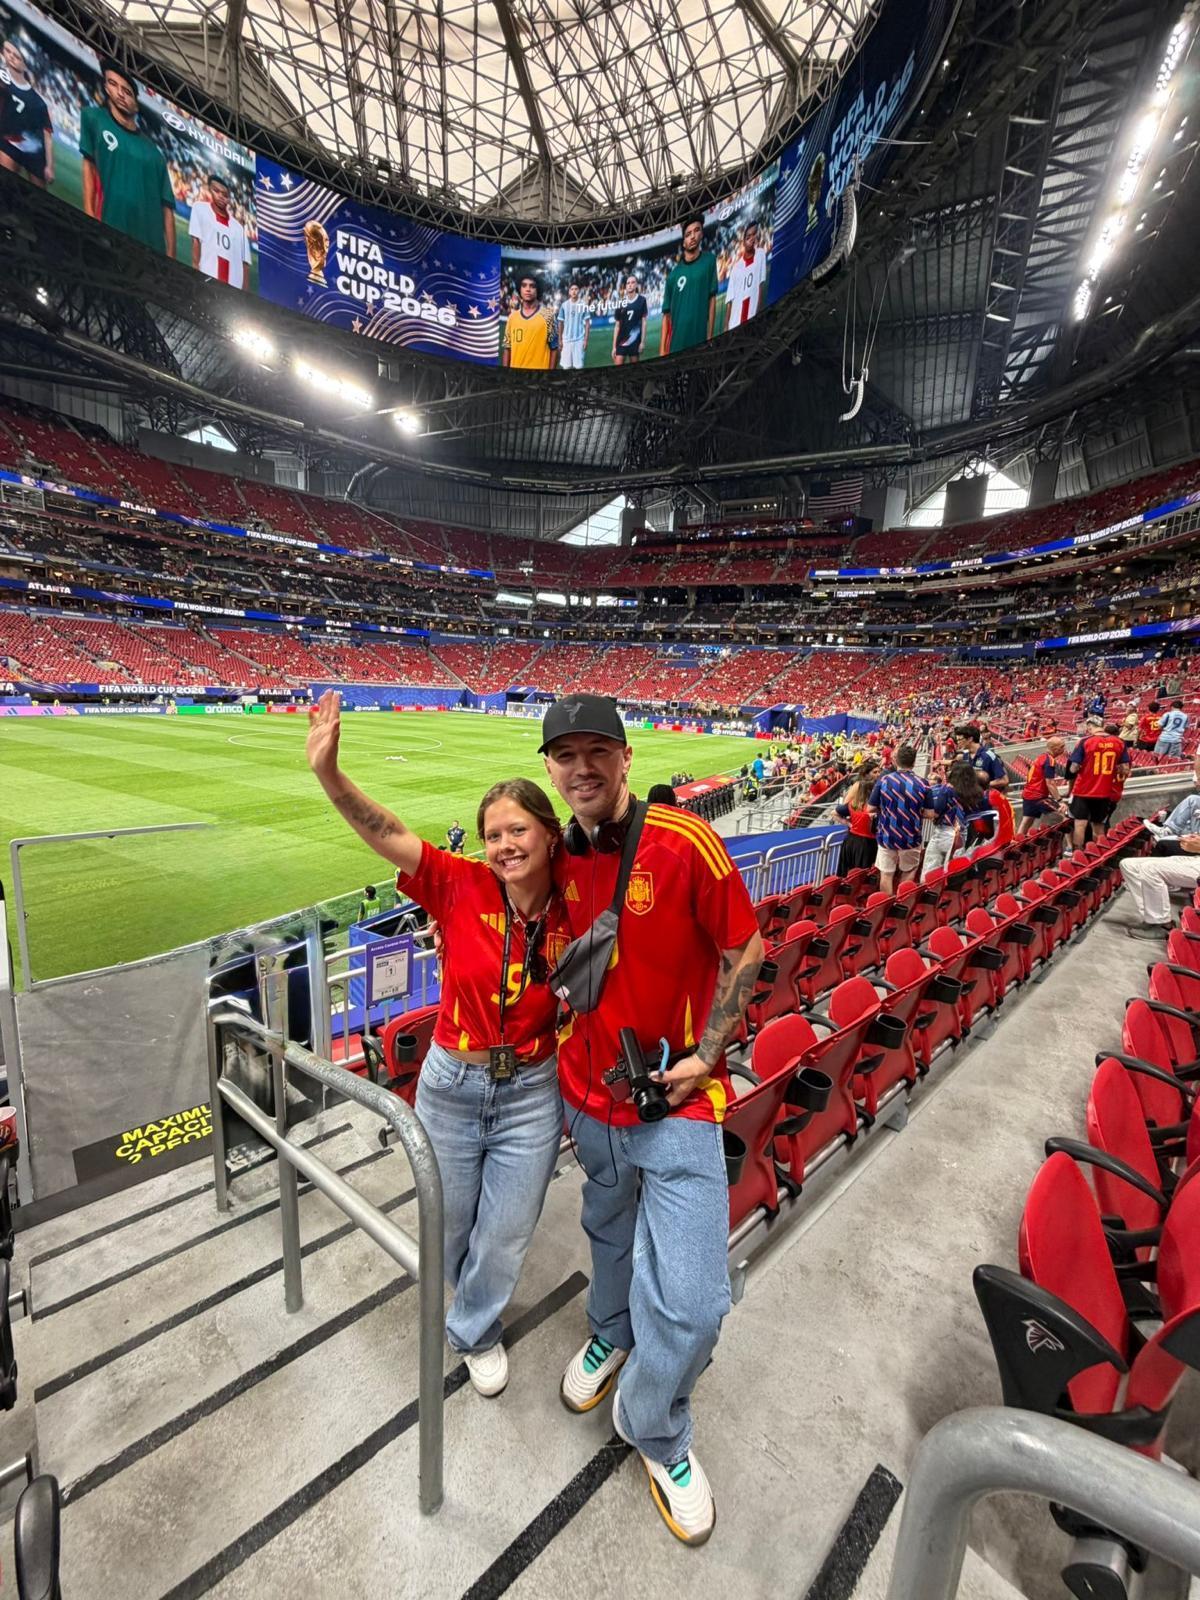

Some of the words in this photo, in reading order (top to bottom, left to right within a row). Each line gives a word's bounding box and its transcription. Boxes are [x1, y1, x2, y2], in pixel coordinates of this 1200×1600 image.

[11, 94, 26, 114] 7
[831, 89, 865, 157] FIFA
[829, 80, 887, 183] WORLD
[103, 131, 118, 151] 9
[188, 126, 245, 166] HYUNDAI
[735, 175, 772, 211] HYUNDAI
[216, 231, 231, 250] 10
[336, 229, 384, 265] FIFA
[336, 251, 415, 294] WORLD
[677, 275, 687, 292] 9
[743, 272, 754, 291] 10
[336, 275, 380, 304] CUP
[383, 291, 457, 327] 2026
[576, 302, 596, 313] The
[597, 299, 628, 312] future
[627, 310, 634, 321] 7
[513, 328, 524, 343] 10
[120, 501, 157, 515] ATLANTA
[246, 530, 261, 539] FIFA
[261, 533, 284, 543] WORLD
[284, 537, 297, 545] CUP
[1073, 535, 1090, 545] FIFA
[1090, 528, 1110, 541] WORLD
[1110, 522, 1122, 534] CUP
[951, 558, 983, 568] ATLANTA
[152, 572, 185, 582] ATLANTA
[28, 582, 72, 595] ATLANTA
[1111, 591, 1140, 602] ATLANTA
[173, 601, 189, 610] FIFA
[189, 603, 211, 613] WORLD
[211, 606, 223, 614] CUP
[334, 600, 361, 608] ATLANTA
[325, 620, 352, 628] ATLANTA
[1067, 636, 1080, 645] FIFA
[1079, 633, 1099, 643] WORLD
[1099, 631, 1110, 640] CUP
[1109, 628, 1132, 639] 2026
[99, 685, 121, 693] FIFA
[121, 686, 157, 694] WORLD
[157, 686, 176, 694] CUP
[176, 686, 207, 695] 2026
[205, 705, 243, 714] aramco
[1172, 717, 1183, 731] 9
[723, 729, 747, 737] HYUNDAI
[1093, 751, 1117, 775] 10
[490, 962, 531, 1007] 9
